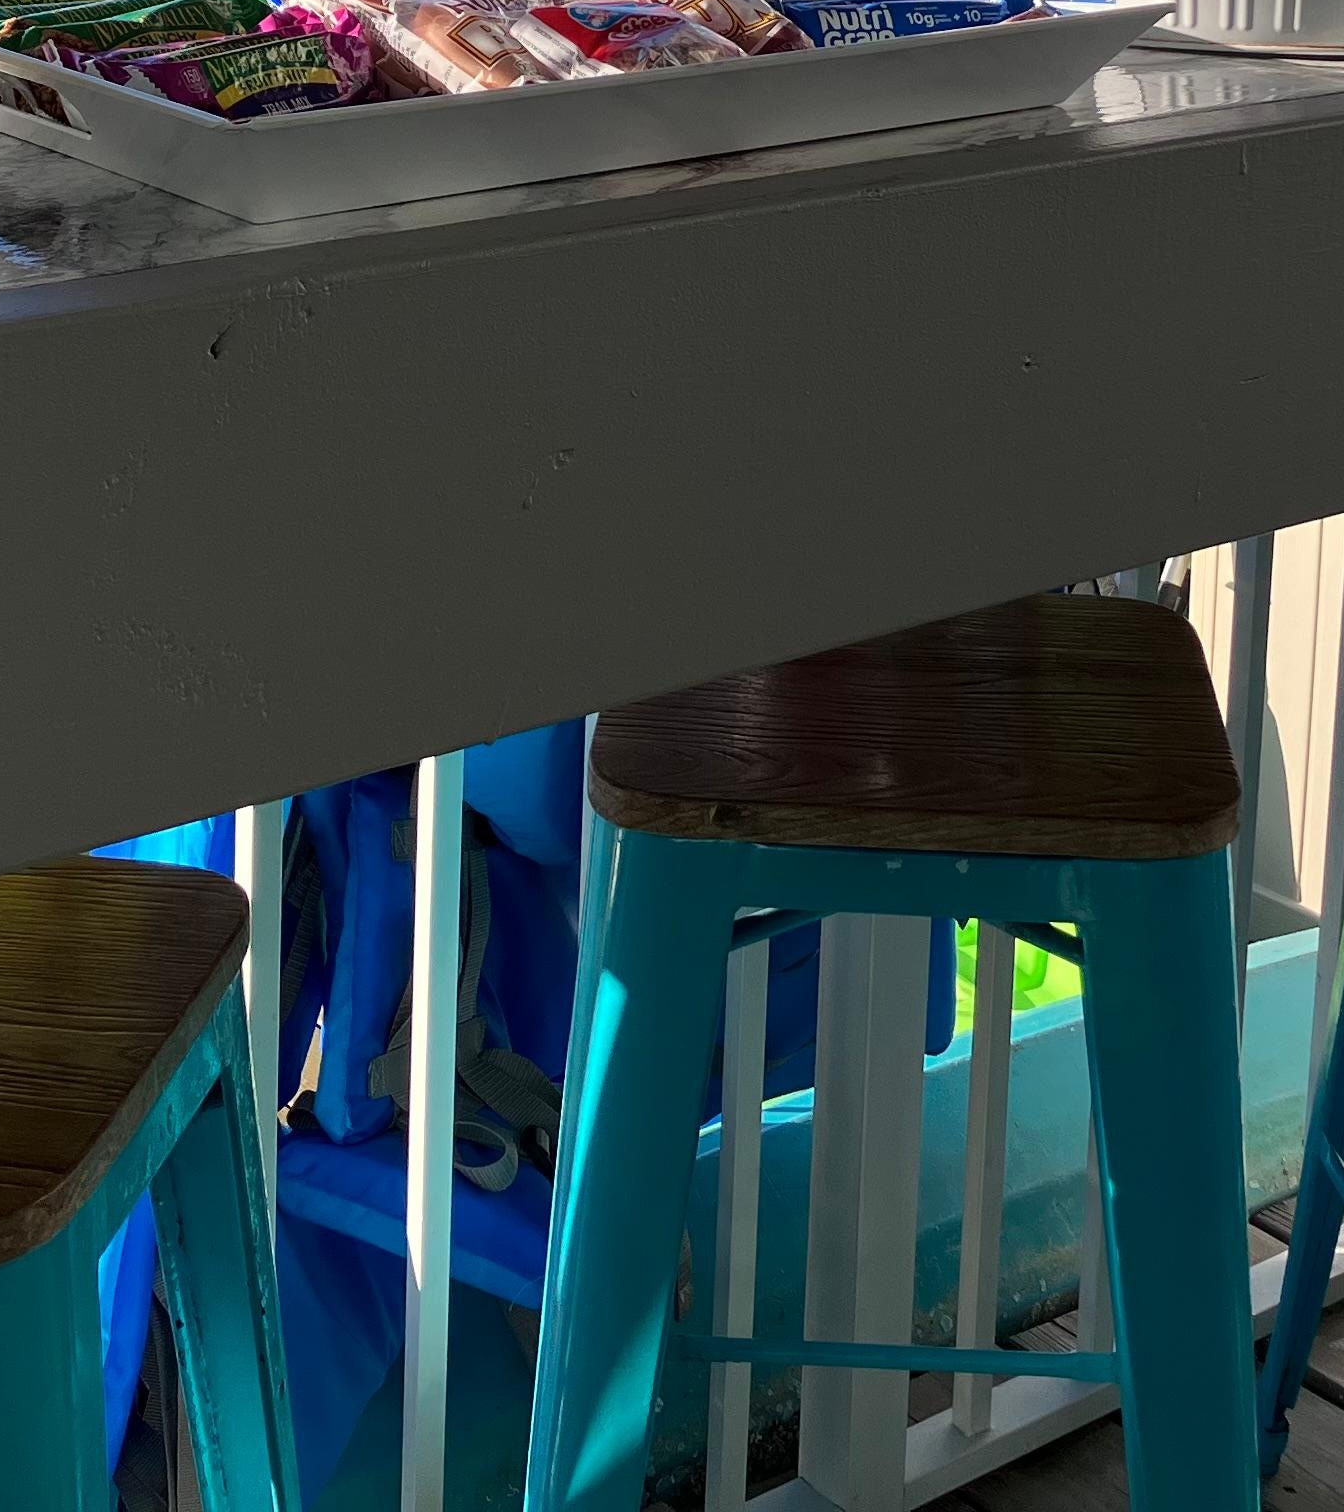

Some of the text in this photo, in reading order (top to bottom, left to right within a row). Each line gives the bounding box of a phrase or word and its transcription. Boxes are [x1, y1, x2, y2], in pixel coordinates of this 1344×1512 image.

[817, 3, 894, 33] Nutri
[905, 12, 935, 28] 10g
[963, 9, 981, 23] 10
